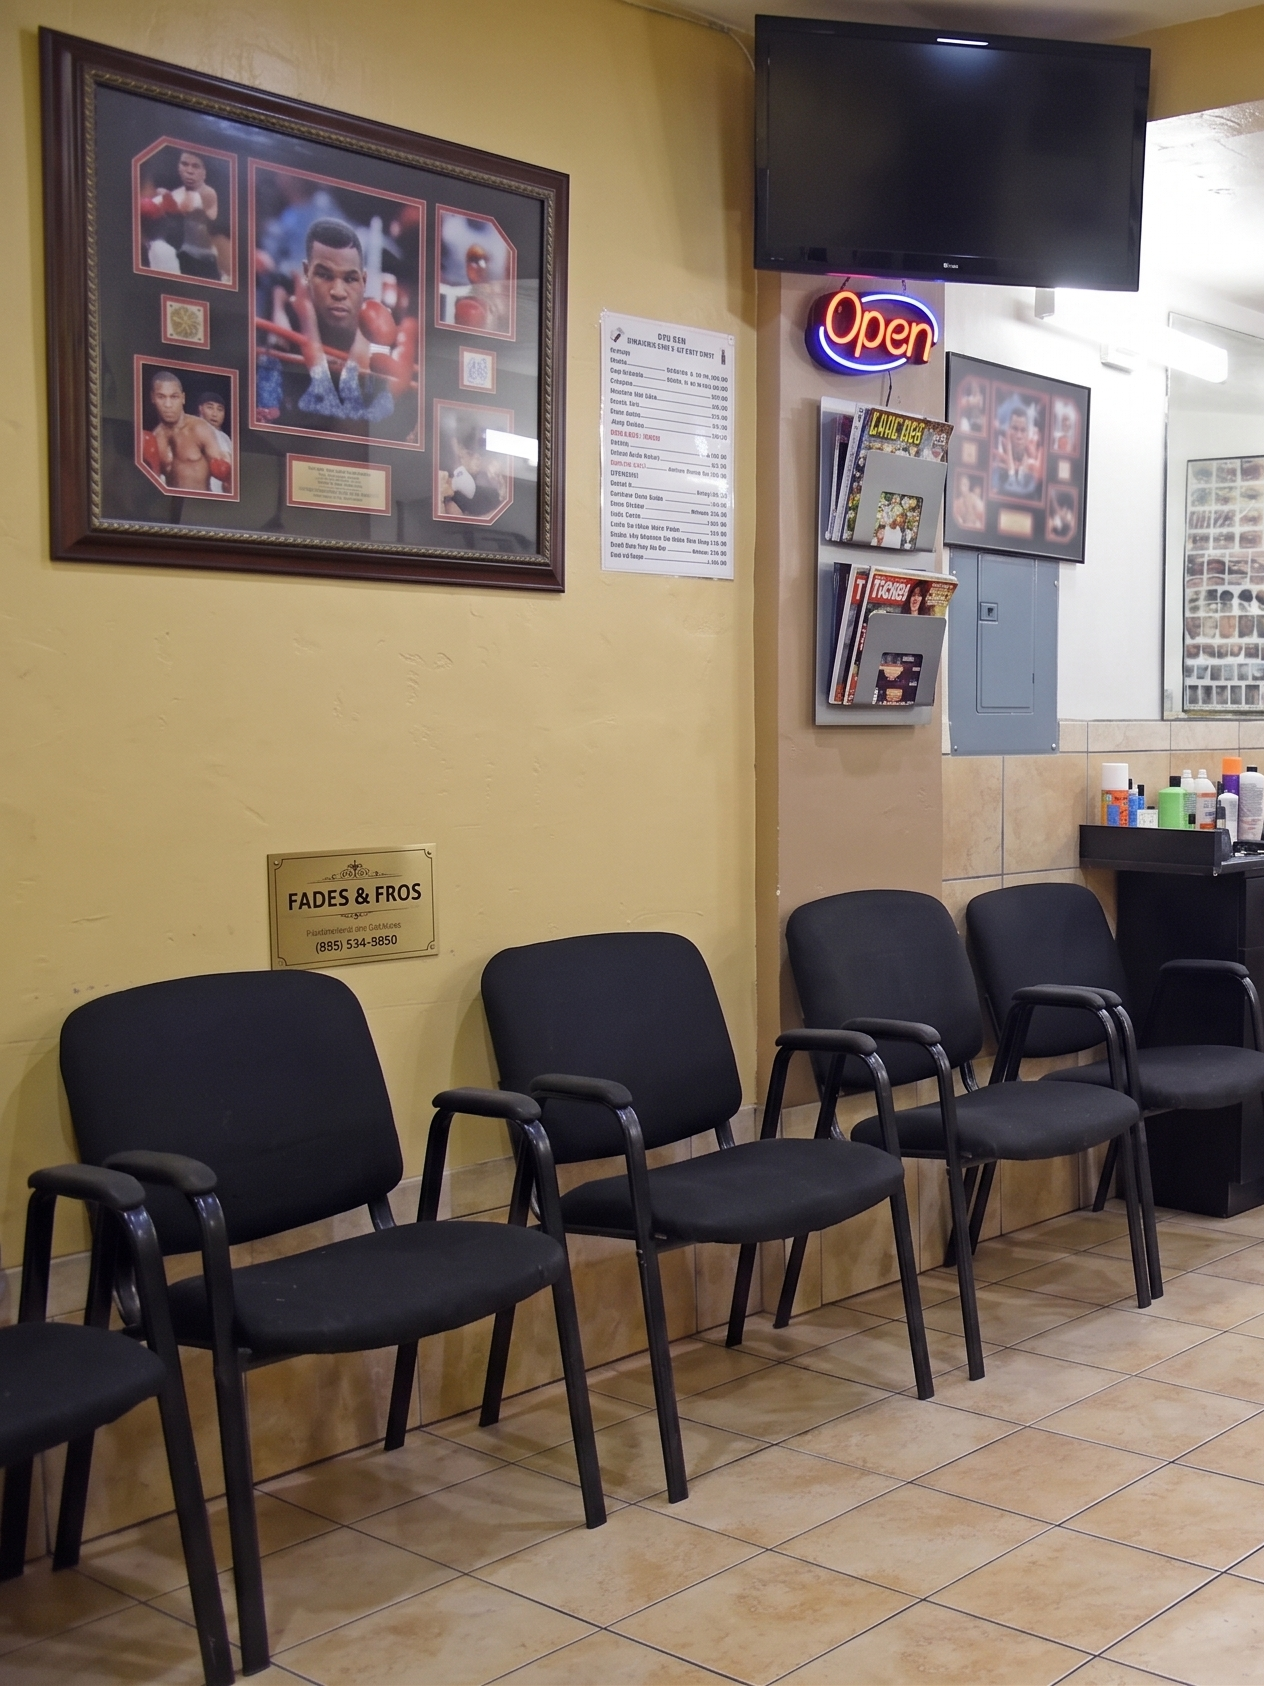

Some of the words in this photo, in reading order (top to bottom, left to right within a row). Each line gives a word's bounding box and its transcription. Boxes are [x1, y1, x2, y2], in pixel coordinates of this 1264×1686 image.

[825, 290, 933, 362] Open
[288, 888, 350, 911] FADES
[354, 887, 371, 905] &
[375, 883, 422, 903] FROS
